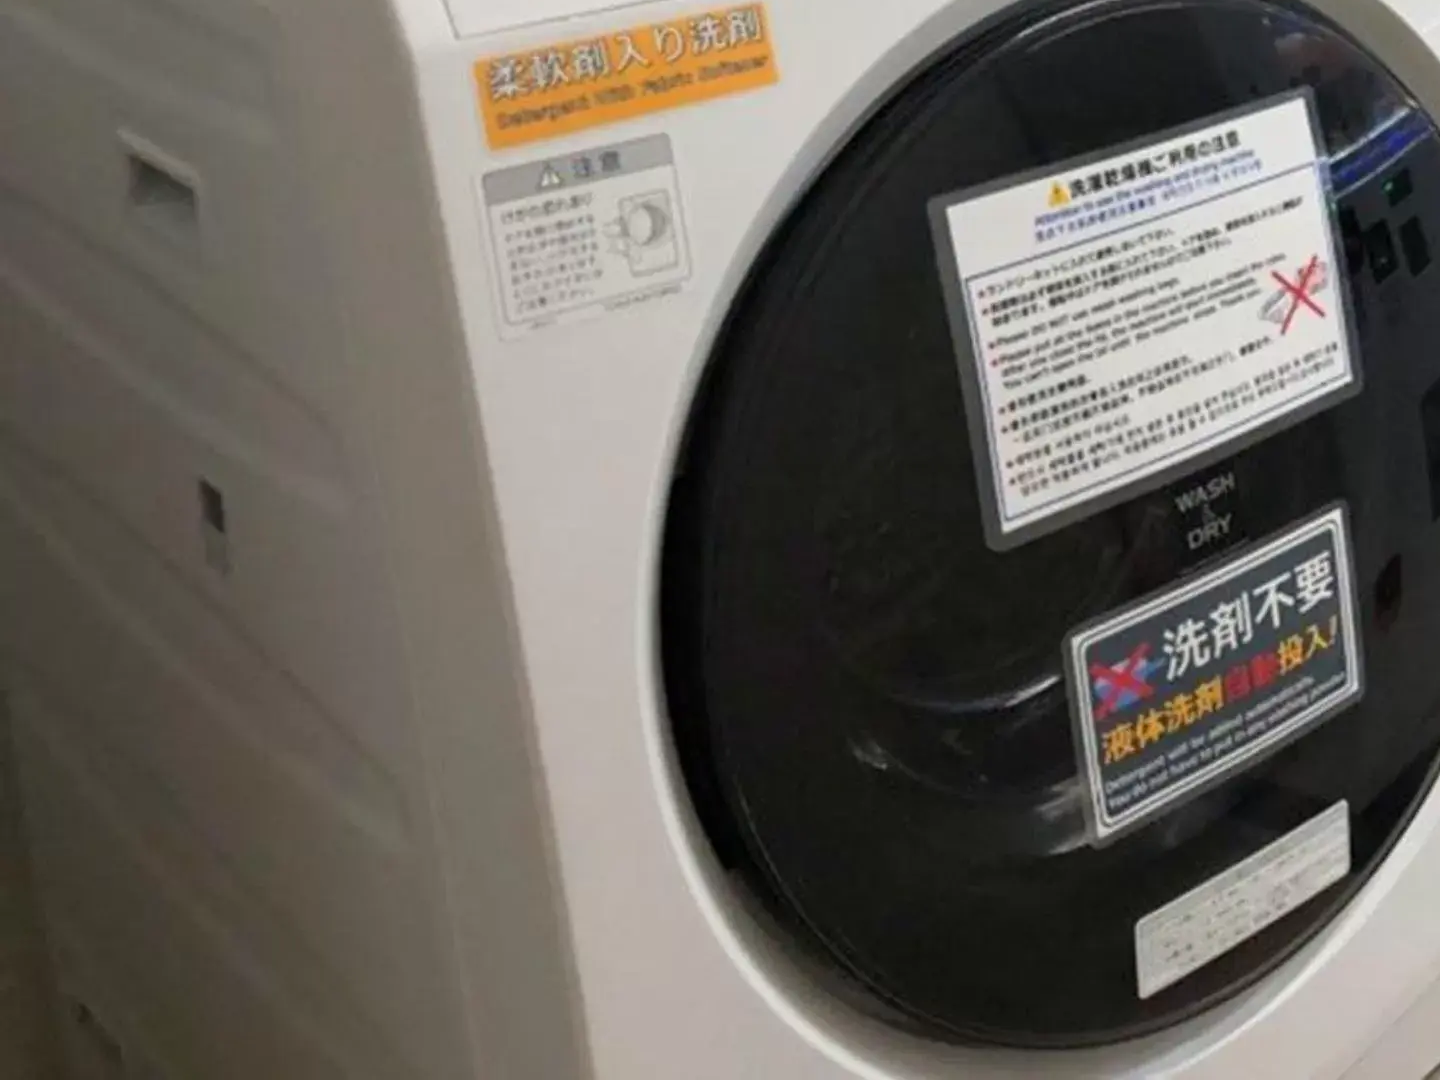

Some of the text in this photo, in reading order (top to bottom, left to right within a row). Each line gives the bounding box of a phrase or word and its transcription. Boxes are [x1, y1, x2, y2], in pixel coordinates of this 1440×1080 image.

[489, 7, 763, 101] 柔軟剤入り洗剤
[1173, 471, 1236, 515] WASH
[1186, 512, 1234, 551] DRY
[1161, 549, 1336, 682] 洗剤不要
